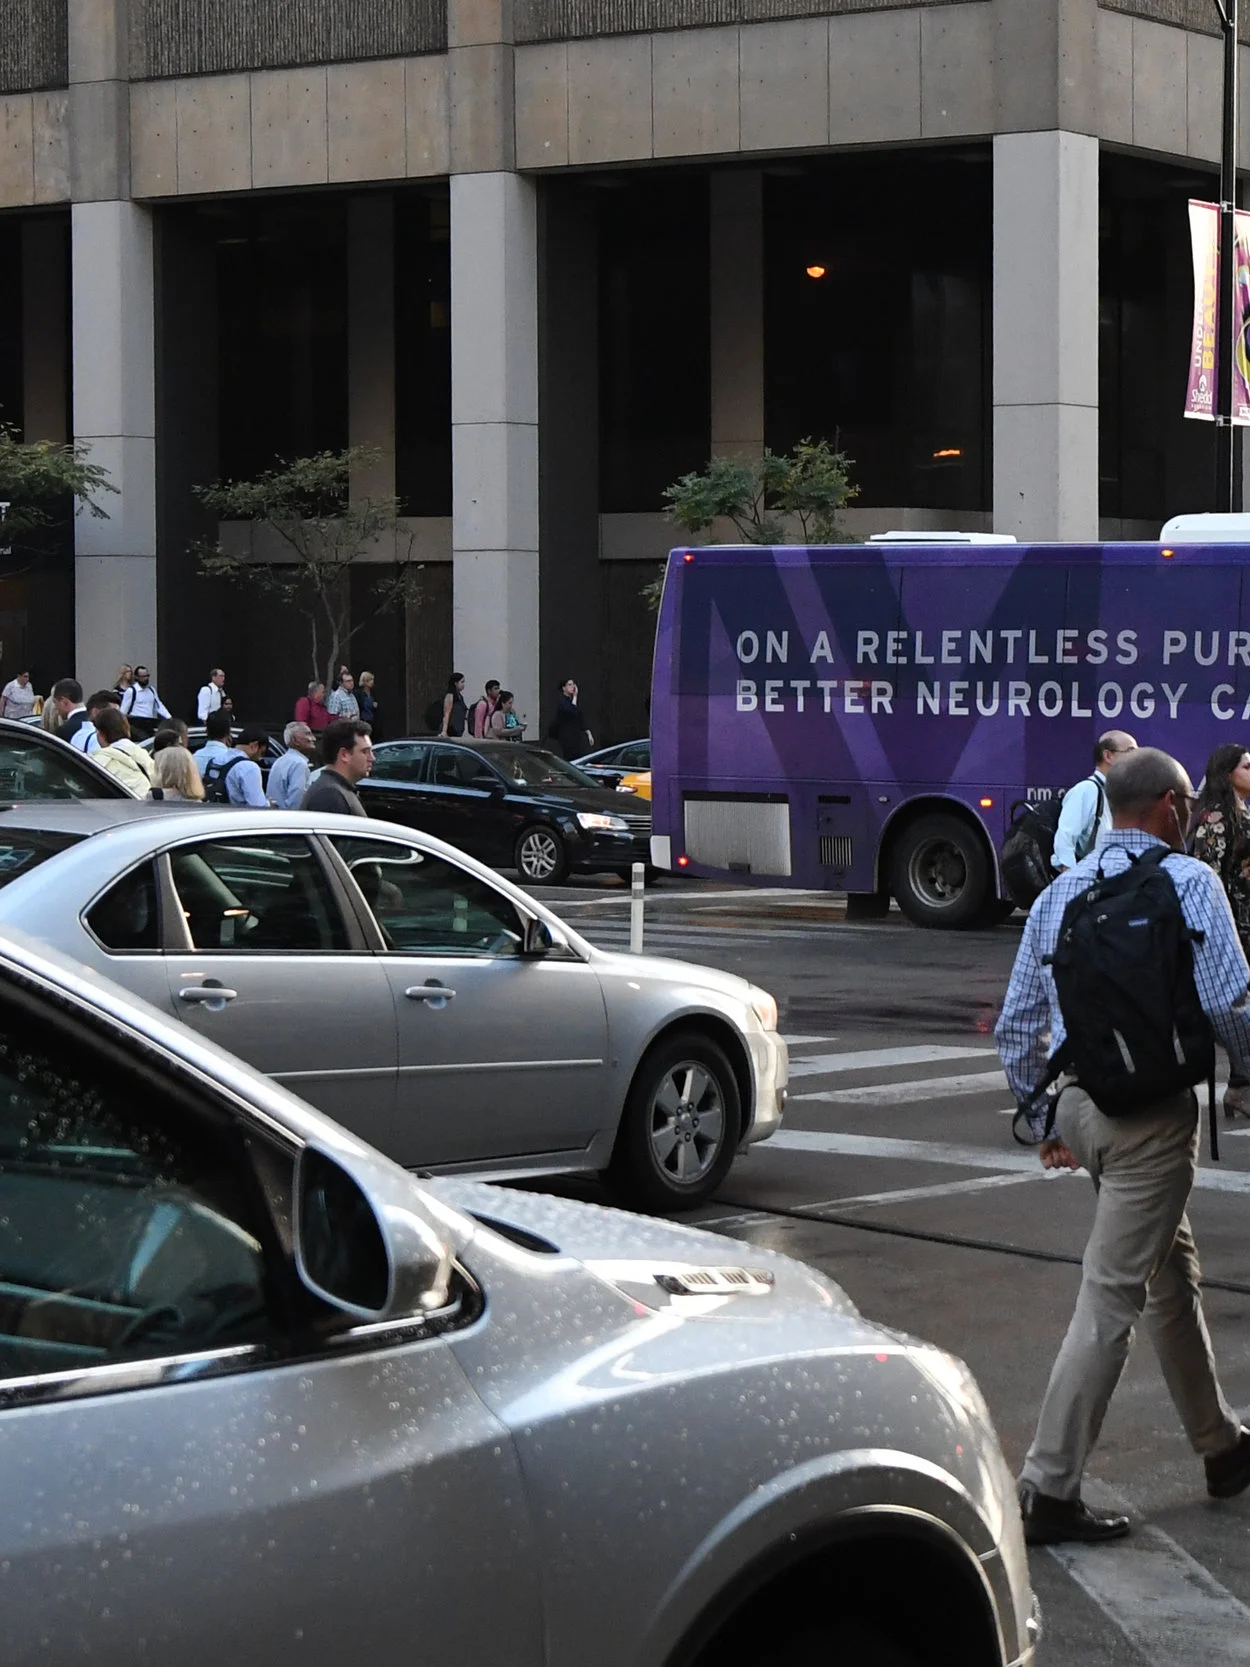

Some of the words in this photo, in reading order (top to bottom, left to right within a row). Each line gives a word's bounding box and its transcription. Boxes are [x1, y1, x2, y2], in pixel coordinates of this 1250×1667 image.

[737, 630, 789, 665] ON
[809, 630, 835, 664] A
[856, 629, 1139, 666] RELENTLESS
[736, 679, 894, 715] BETTER
[916, 680, 1189, 719] NEUROLOGY
